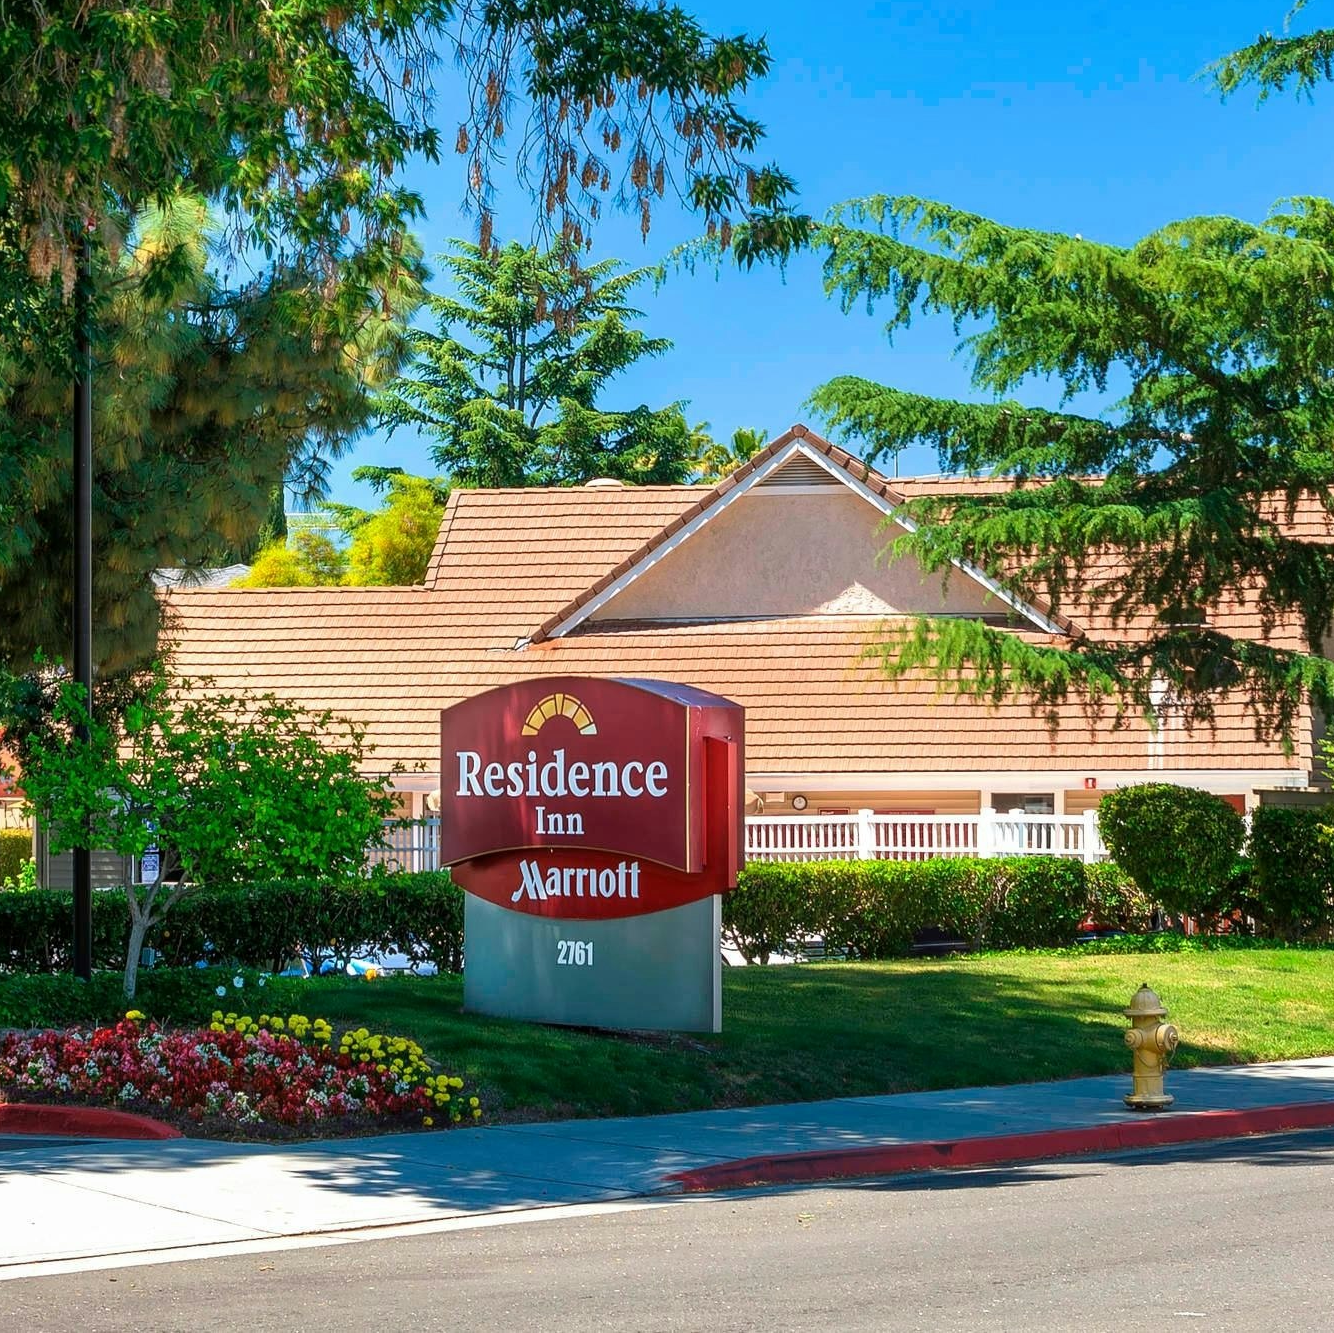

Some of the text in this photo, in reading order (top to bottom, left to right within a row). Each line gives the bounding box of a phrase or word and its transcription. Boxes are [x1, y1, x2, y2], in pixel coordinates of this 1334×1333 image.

[455, 748, 668, 798] Residence
[535, 806, 585, 835] Inn
[511, 859, 641, 902] Marriott
[557, 940, 594, 966] 2761
